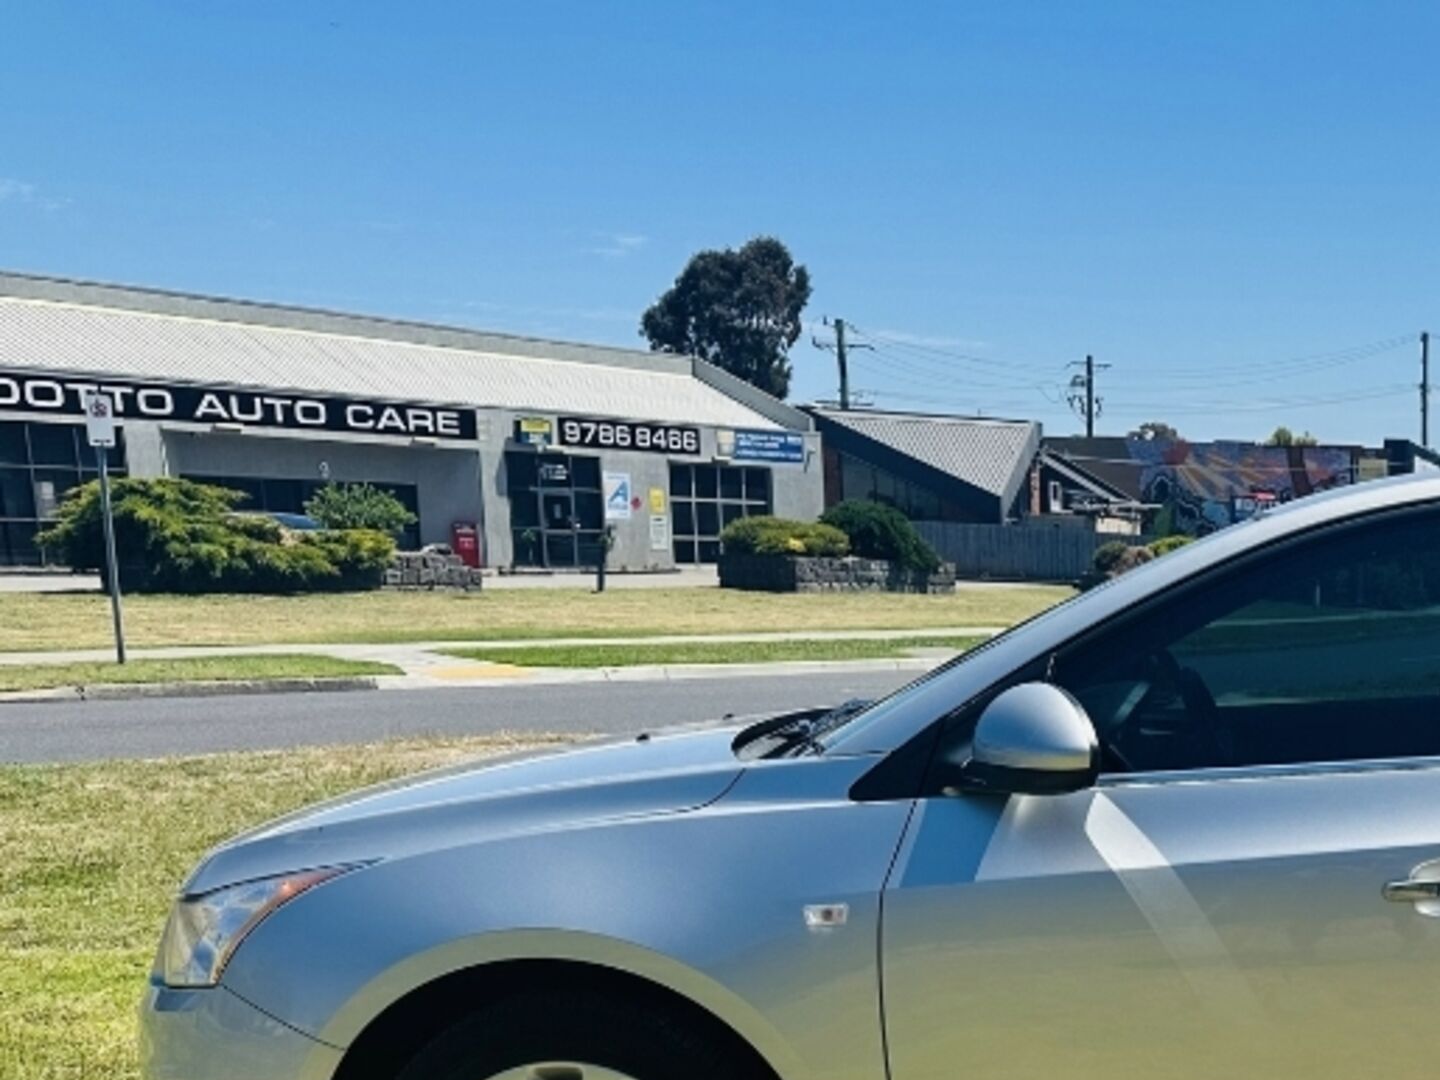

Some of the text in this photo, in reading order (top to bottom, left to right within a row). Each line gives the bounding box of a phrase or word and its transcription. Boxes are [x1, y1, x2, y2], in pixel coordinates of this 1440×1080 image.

[194, 393, 326, 425] AUTO
[346, 404, 460, 435] CARE
[564, 421, 631, 447] 9786
